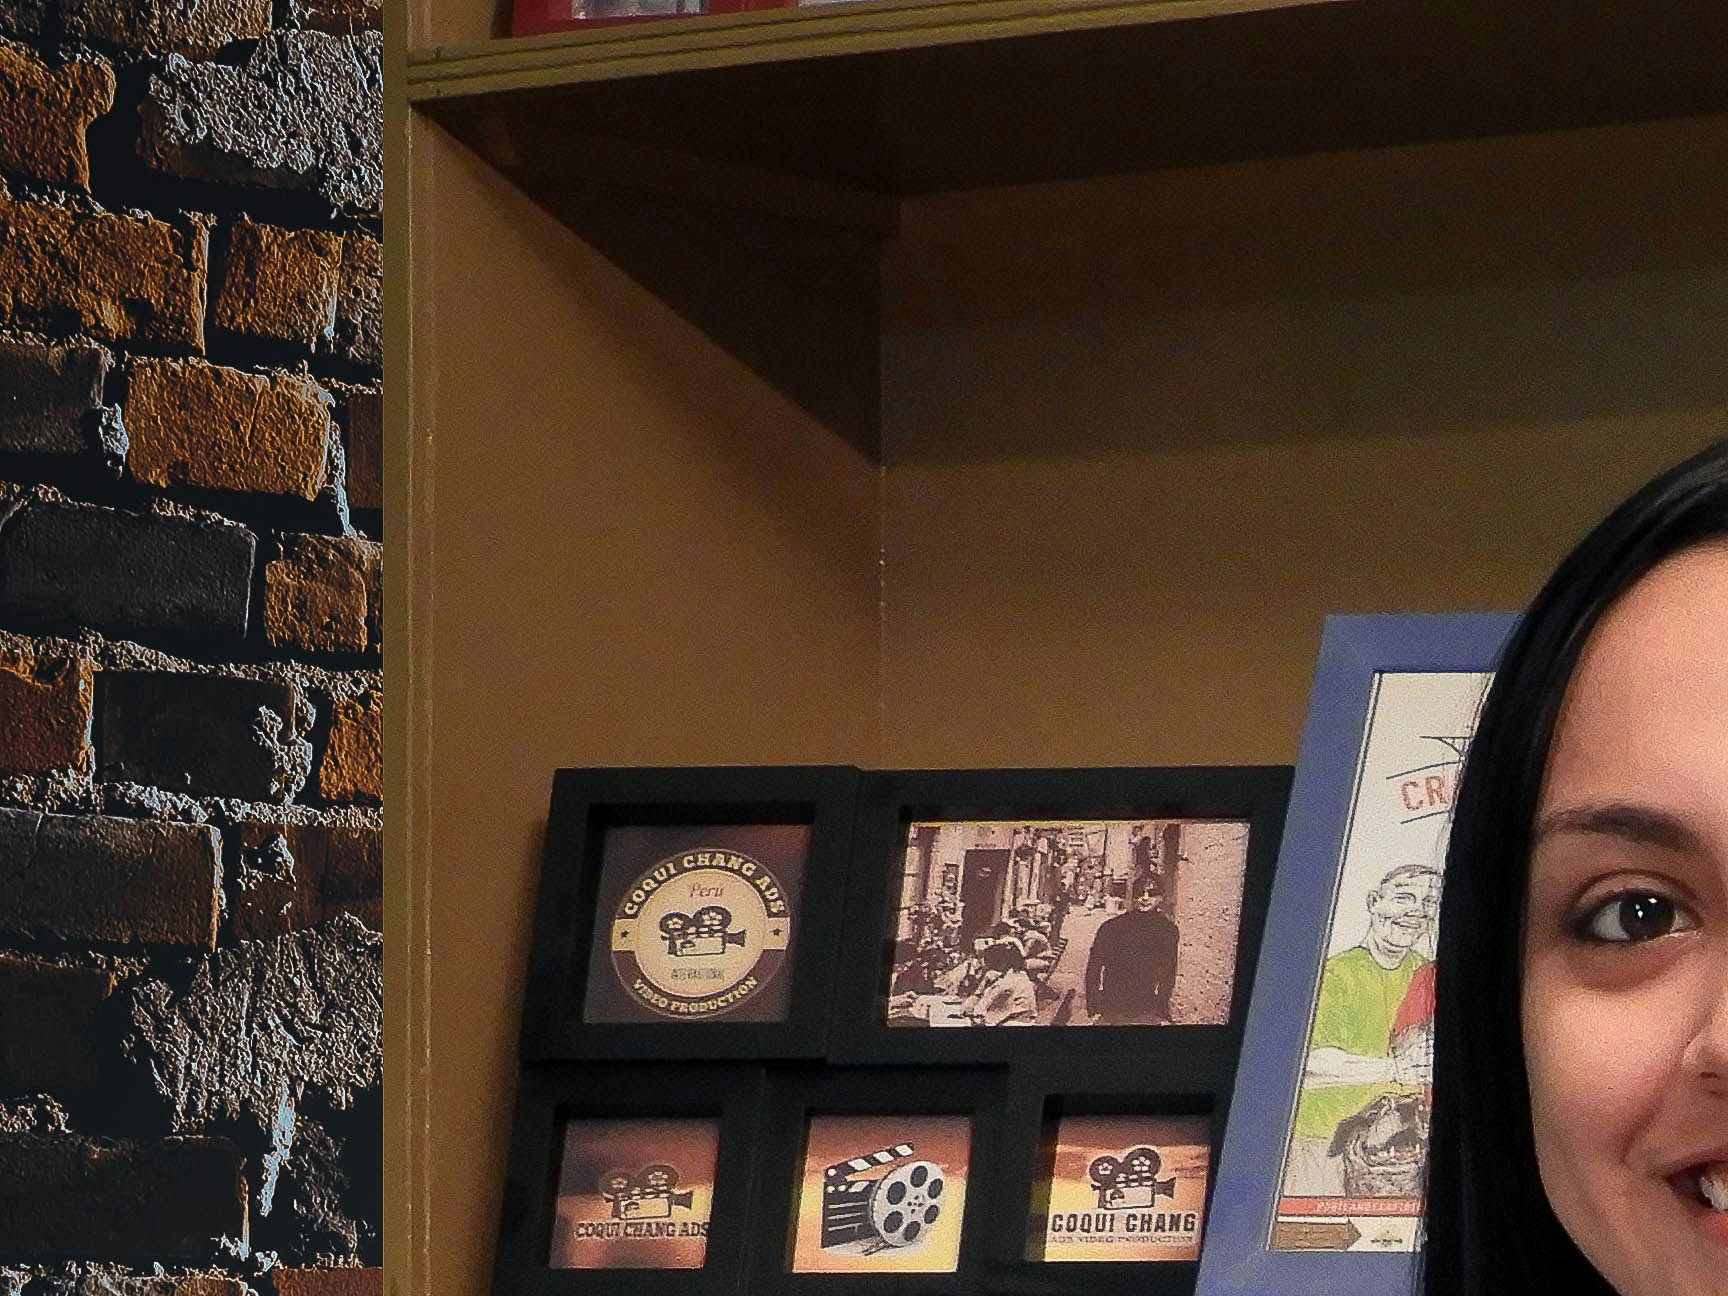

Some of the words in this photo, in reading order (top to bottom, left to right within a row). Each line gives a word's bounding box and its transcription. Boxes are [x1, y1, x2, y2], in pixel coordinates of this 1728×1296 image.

[624, 862, 677, 915] COQUI
[683, 853, 757, 876] CHANG
[756, 875, 786, 913] ADS
[633, 978, 668, 1008] VIDEO
[670, 975, 758, 1014] PRODUCTION
[1051, 1213, 1115, 1233] COQUI
[1125, 1213, 1197, 1233] CHANG
